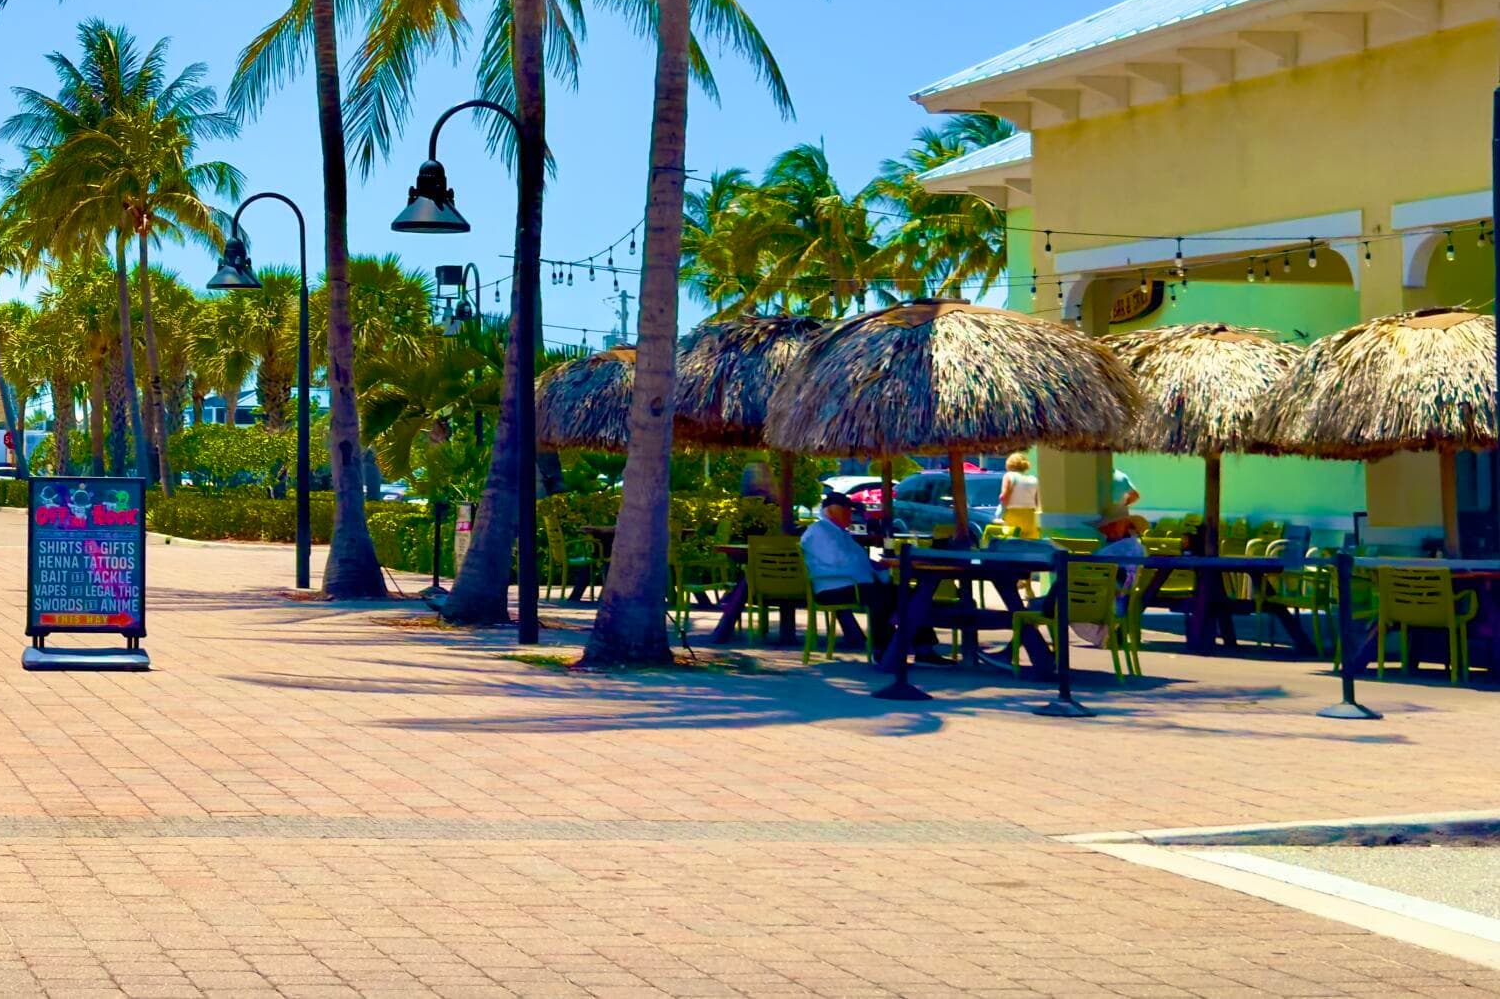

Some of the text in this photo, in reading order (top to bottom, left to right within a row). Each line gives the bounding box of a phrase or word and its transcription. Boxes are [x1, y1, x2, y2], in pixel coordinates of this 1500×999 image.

[39, 540, 83, 554] SHIRTS
[100, 541, 135, 555] GIFTS
[38, 555, 135, 570] HENNA TATTOOS
[40, 570, 68, 583] BAIT
[87, 570, 133, 584] TACKLE
[34, 584, 67, 596] VAPES
[85, 585, 117, 597] LEGAL
[118, 585, 140, 598] THC
[34, 598, 84, 611] SWORDS
[100, 599, 139, 612] ANIME
